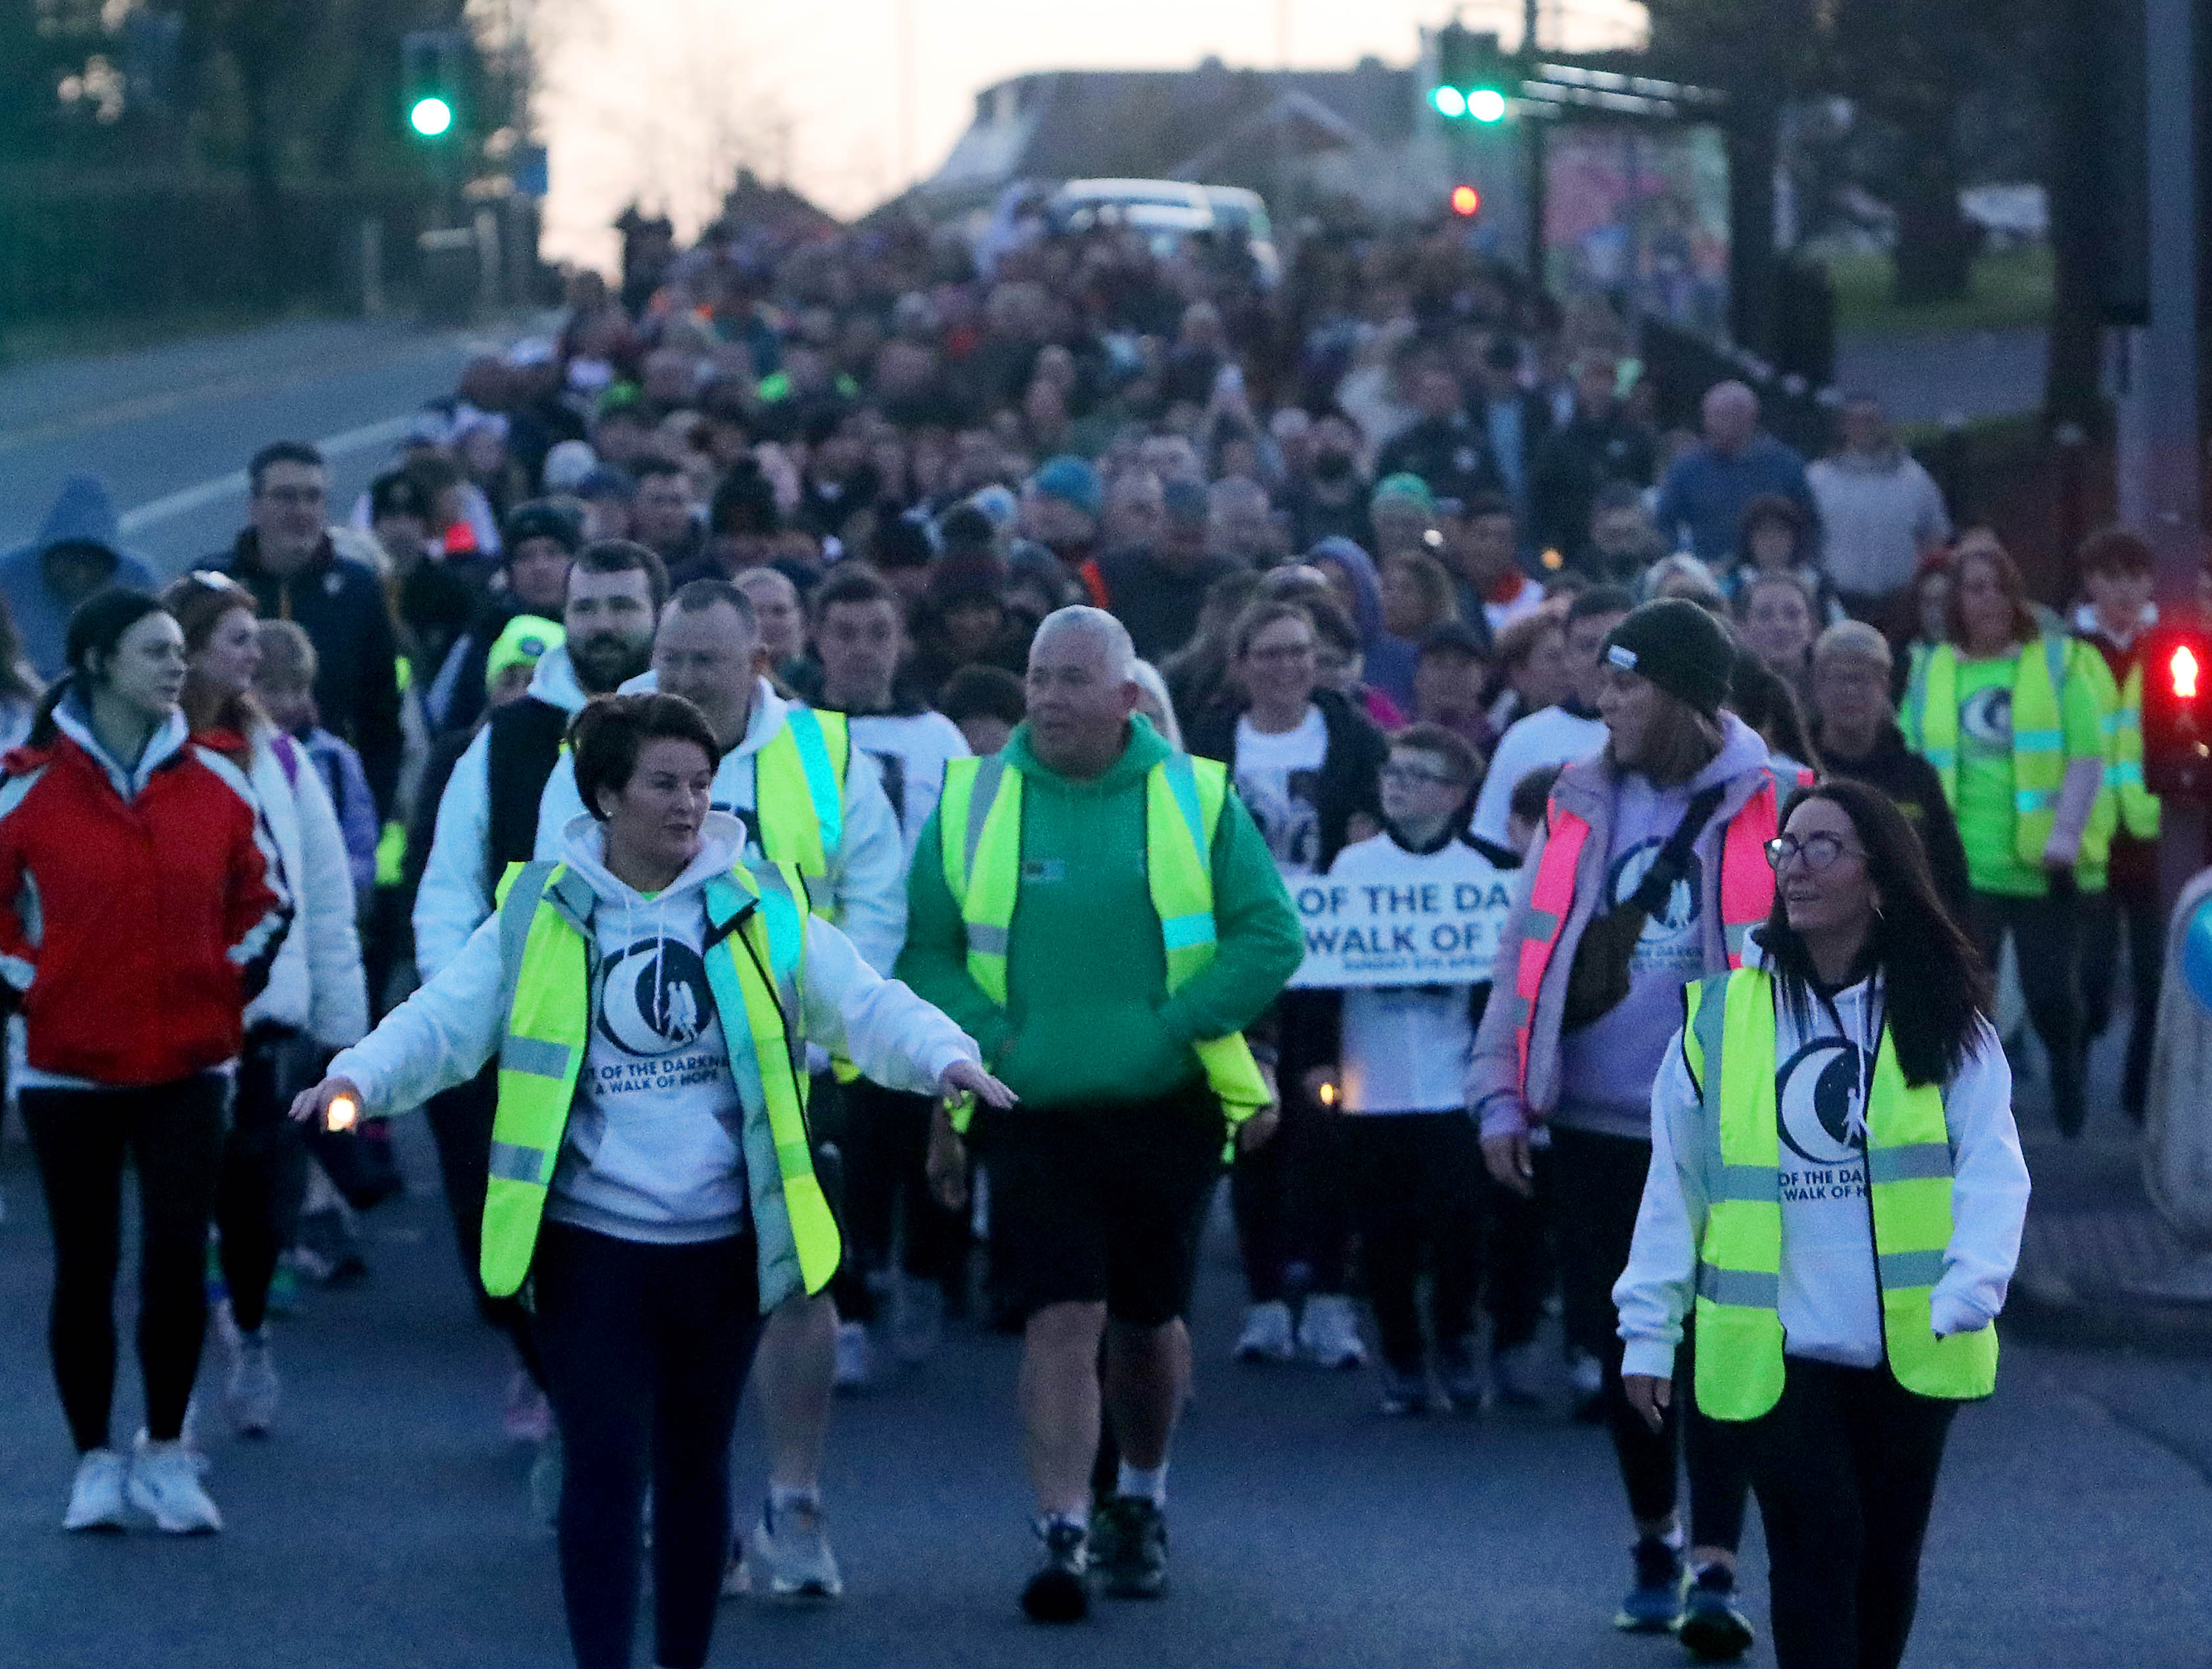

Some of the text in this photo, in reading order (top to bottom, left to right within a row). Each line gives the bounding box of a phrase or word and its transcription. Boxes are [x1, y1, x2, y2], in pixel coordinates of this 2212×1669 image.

[1297, 882, 1509, 915] OF THE DA
[1305, 924, 1416, 954] WALK
[1430, 921, 1481, 952] OF
[601, 1065, 621, 1079] OF
[627, 1061, 657, 1076] THE
[610, 1078, 651, 1093] WALK
[657, 1074, 675, 1088] OF
[1778, 1169, 1863, 1186] OF THE DA
[1784, 1187, 1826, 1201] WALK
[1831, 1185, 1851, 1199] OF
